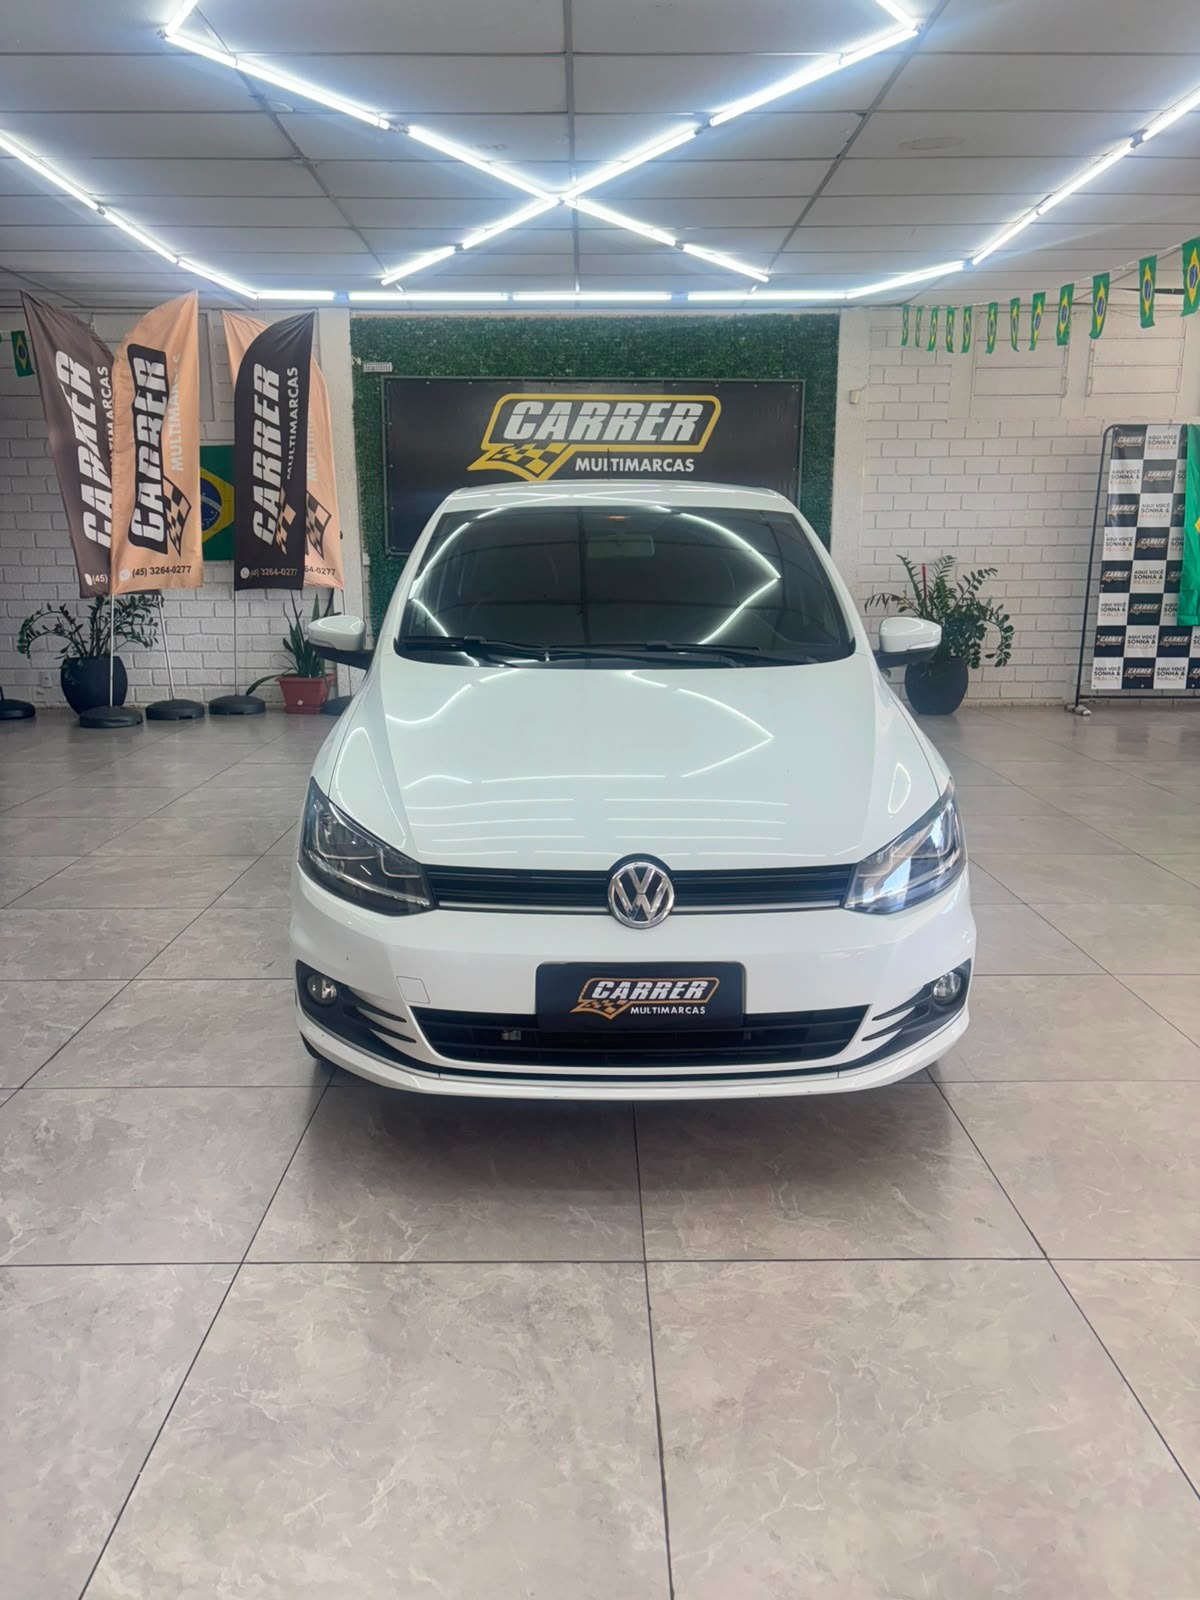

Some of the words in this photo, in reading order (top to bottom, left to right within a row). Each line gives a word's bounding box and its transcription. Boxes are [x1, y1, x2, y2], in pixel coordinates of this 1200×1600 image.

[285, 366, 299, 481] MULTIMARCAS
[503, 401, 704, 442] CARRER
[253, 363, 281, 545] CARRER
[575, 457, 695, 473] MULTIMARCAS
[92, 574, 108, 585] (45)
[132, 567, 148, 578] (45)
[150, 565, 192, 575] 3264-0277
[591, 980, 709, 1000] CARRER
[630, 1006, 706, 1015] MULTIMARCAS
